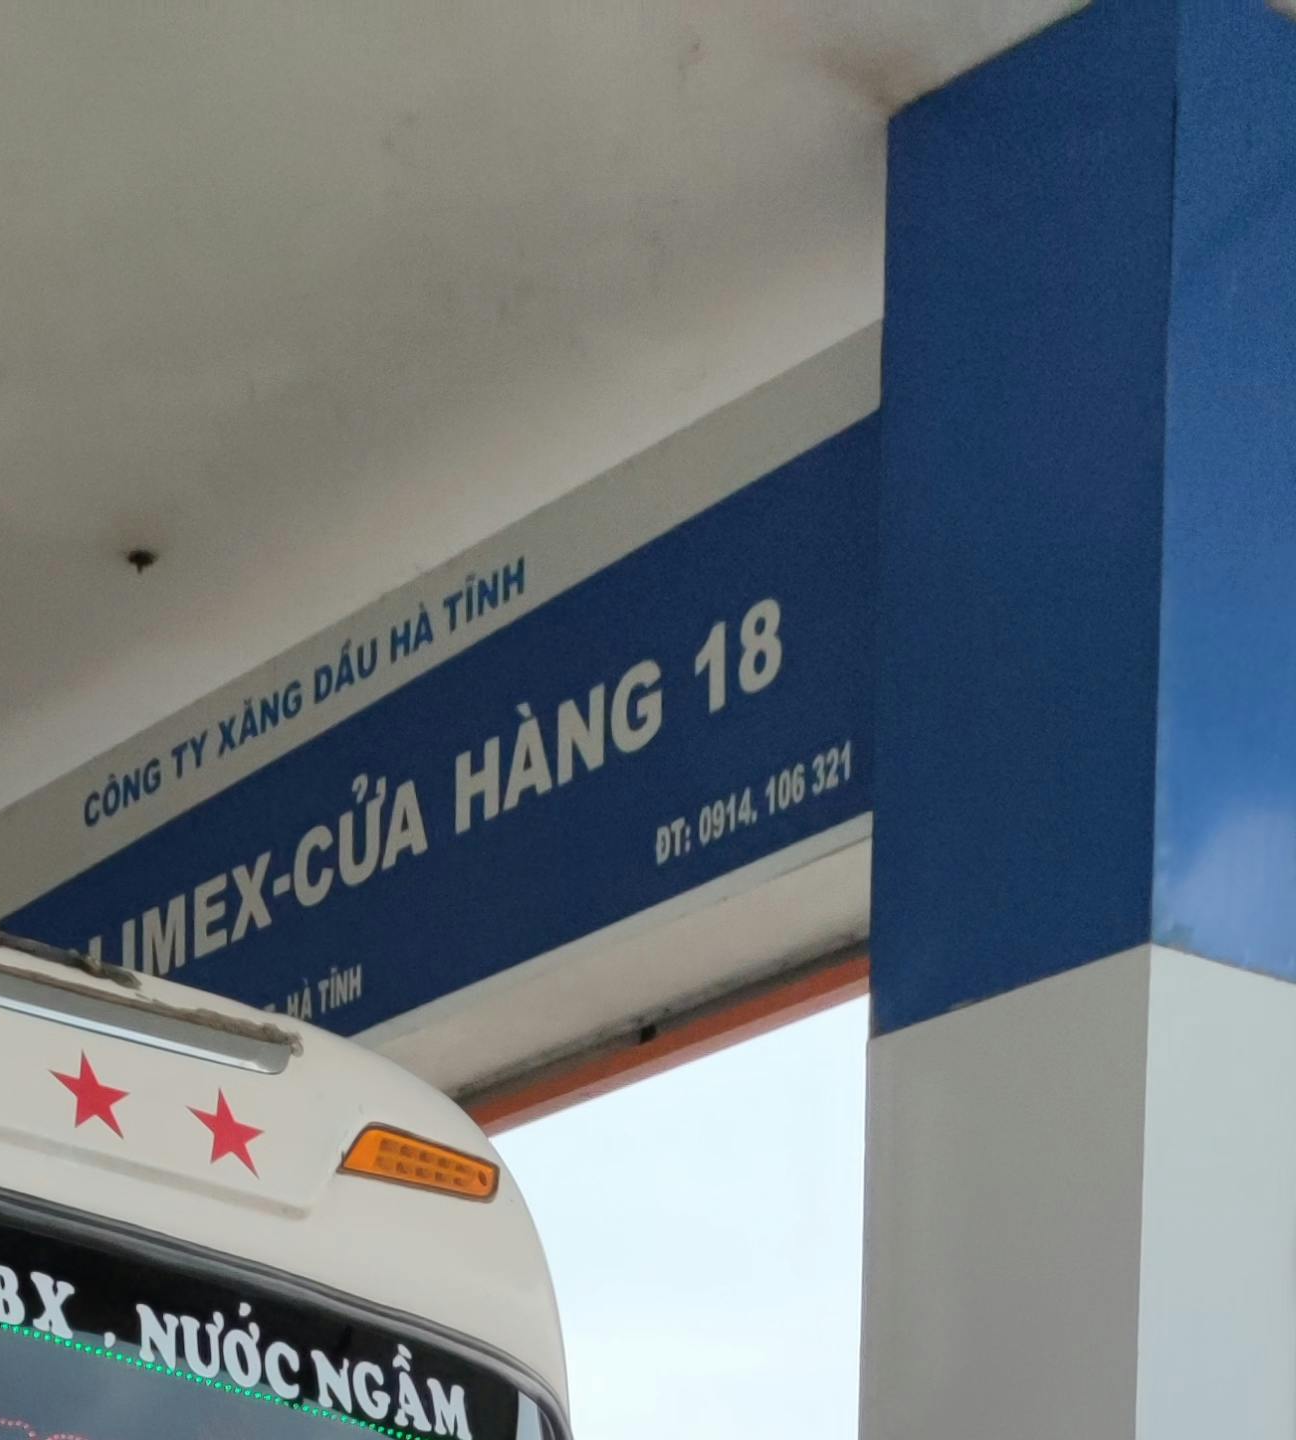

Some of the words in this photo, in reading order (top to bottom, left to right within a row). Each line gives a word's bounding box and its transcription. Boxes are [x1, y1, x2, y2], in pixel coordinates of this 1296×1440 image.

[83, 757, 161, 828] CÔNG
[170, 729, 208, 779] TY
[217, 679, 303, 759] XĂNG
[313, 637, 379, 706] DẤU
[389, 601, 434, 664] HÀ
[442, 556, 526, 634] TĨNH
[454, 659, 664, 836] HÀNG
[693, 597, 784, 717] 18
[655, 816, 692, 866] ĐT:
[698, 786, 758, 847] 0914.
[764, 762, 805, 816] 106
[810, 739, 852, 796] 321
[317, 963, 363, 1015] TĨNH
[136, 1302, 302, 1396] NƯỚC
